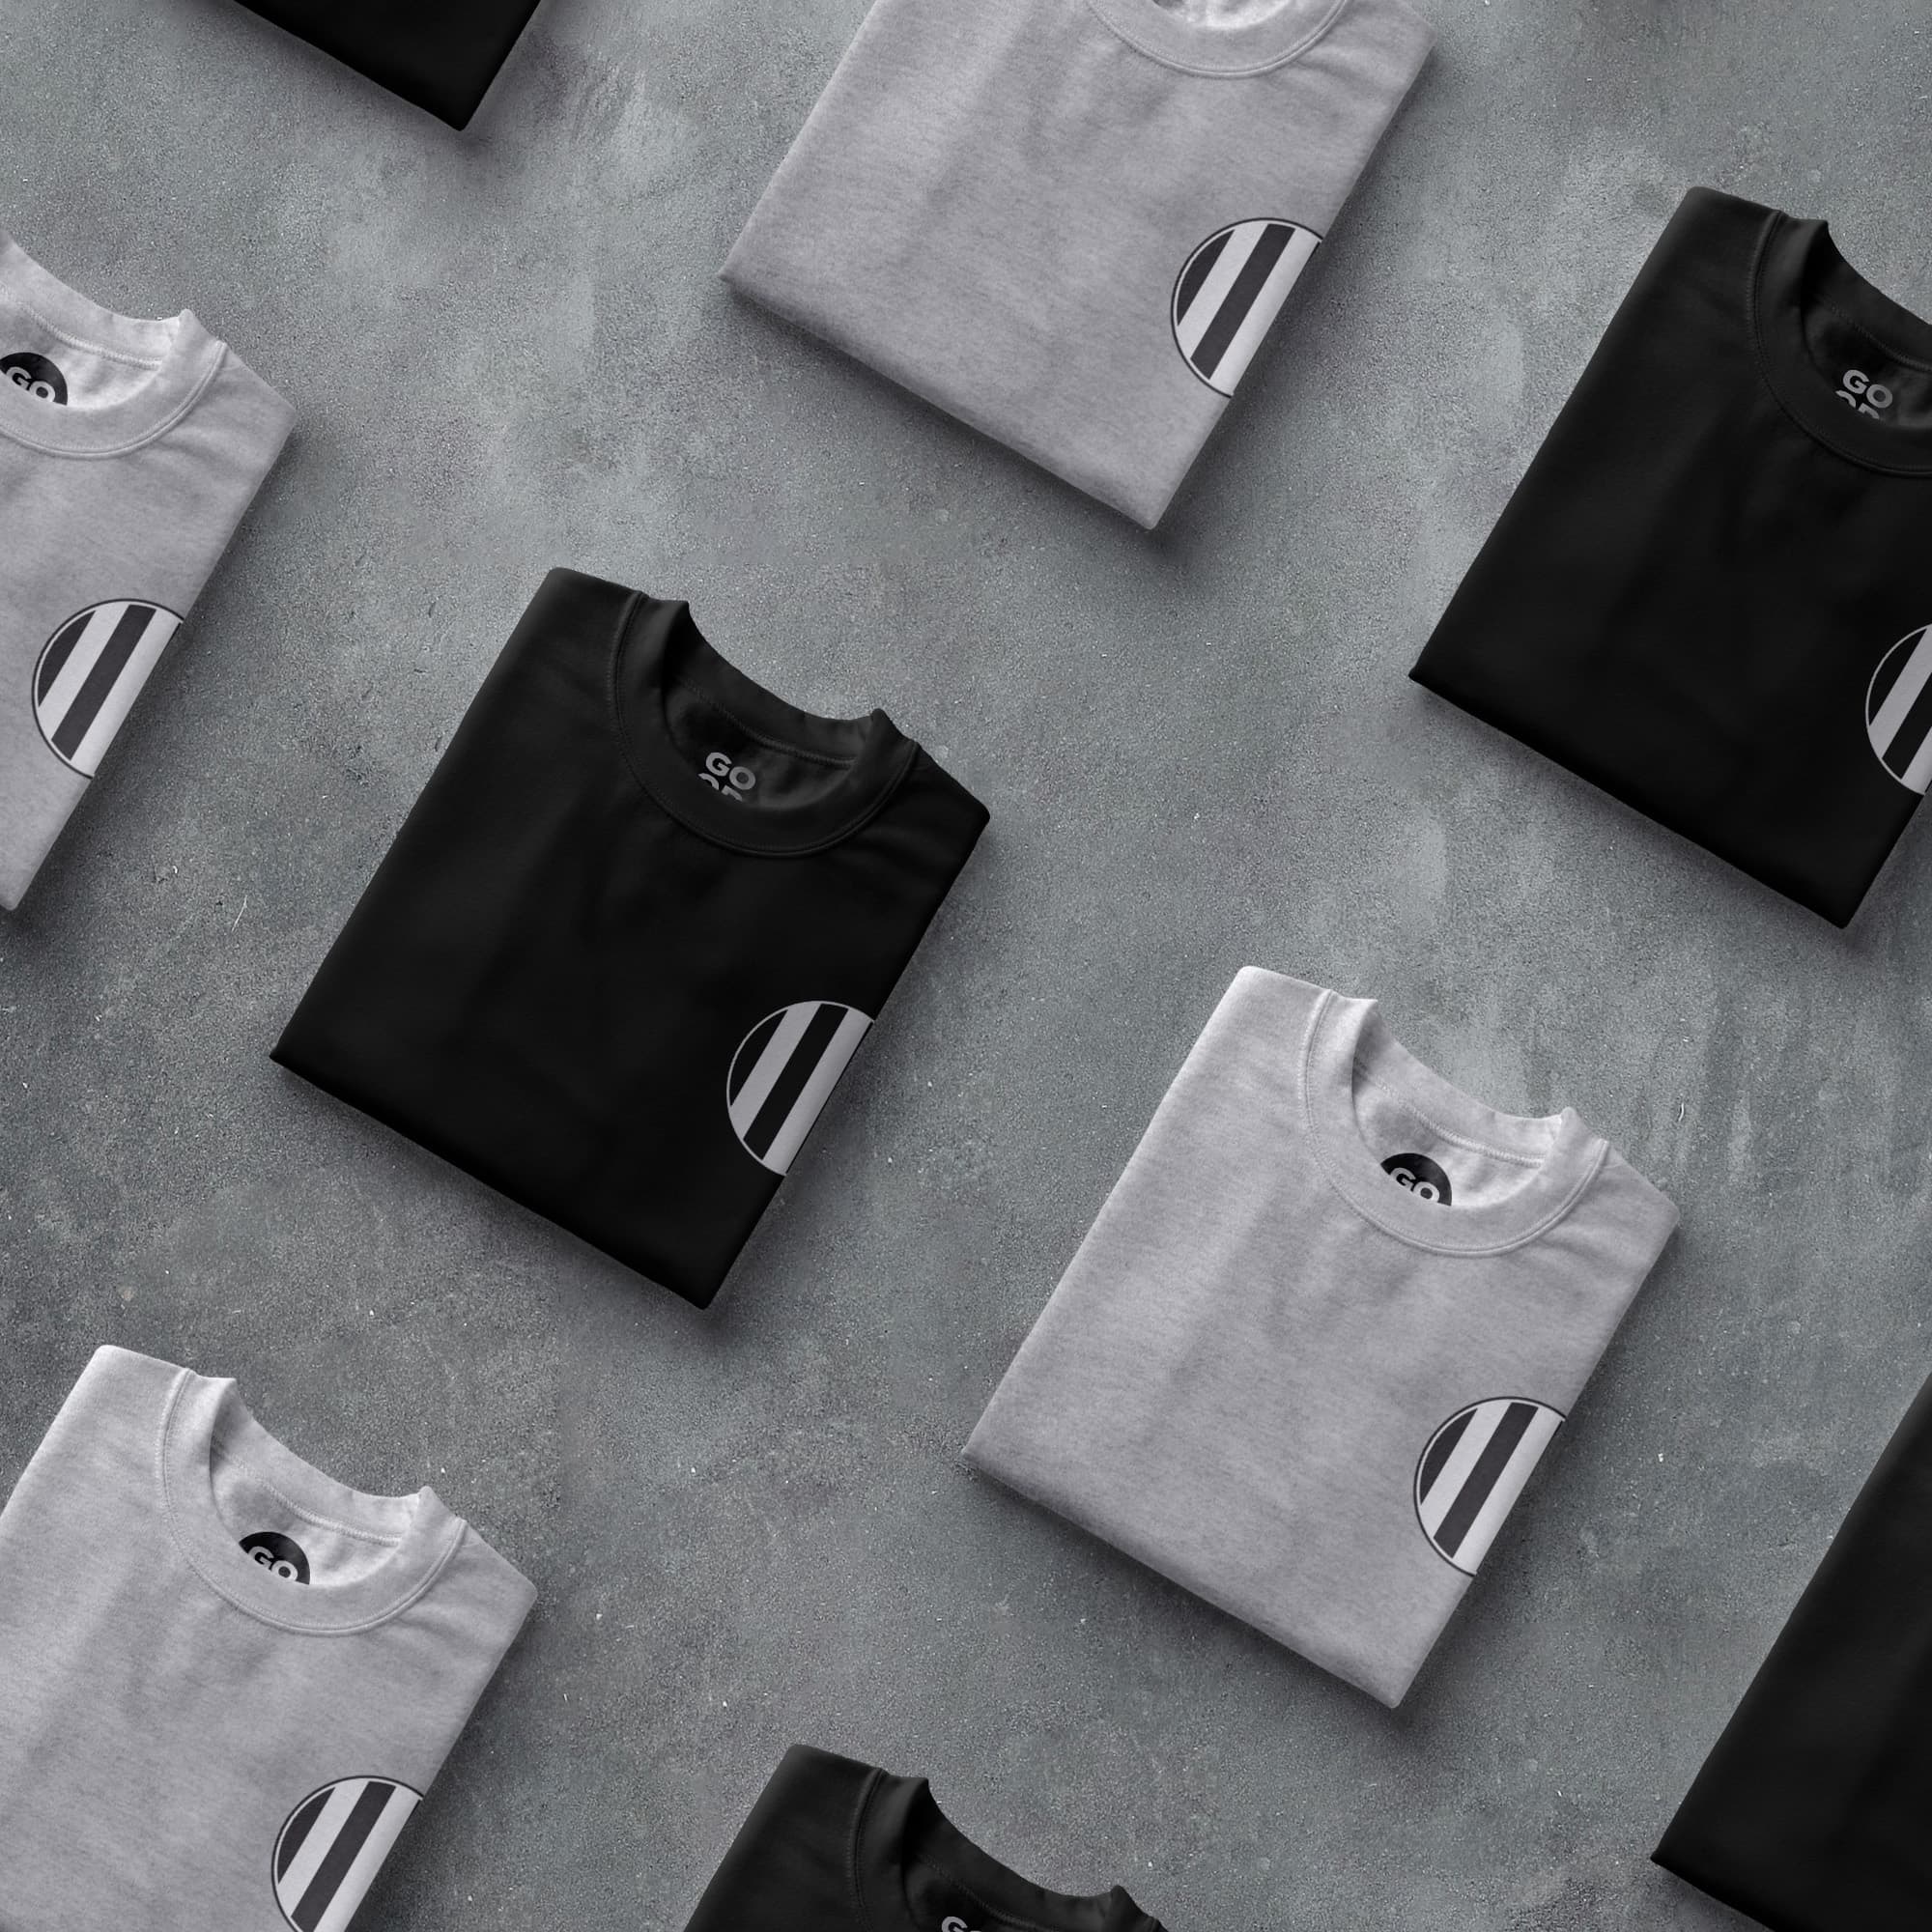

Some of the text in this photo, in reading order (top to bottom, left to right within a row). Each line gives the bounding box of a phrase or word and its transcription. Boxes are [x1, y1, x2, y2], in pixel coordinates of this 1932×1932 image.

[6, 367, 56, 403] GO
[1842, 369, 1893, 409] GO
[705, 752, 756, 790] GO
[1390, 1167, 1440, 1204] GO
[248, 1546, 298, 1582] GO
